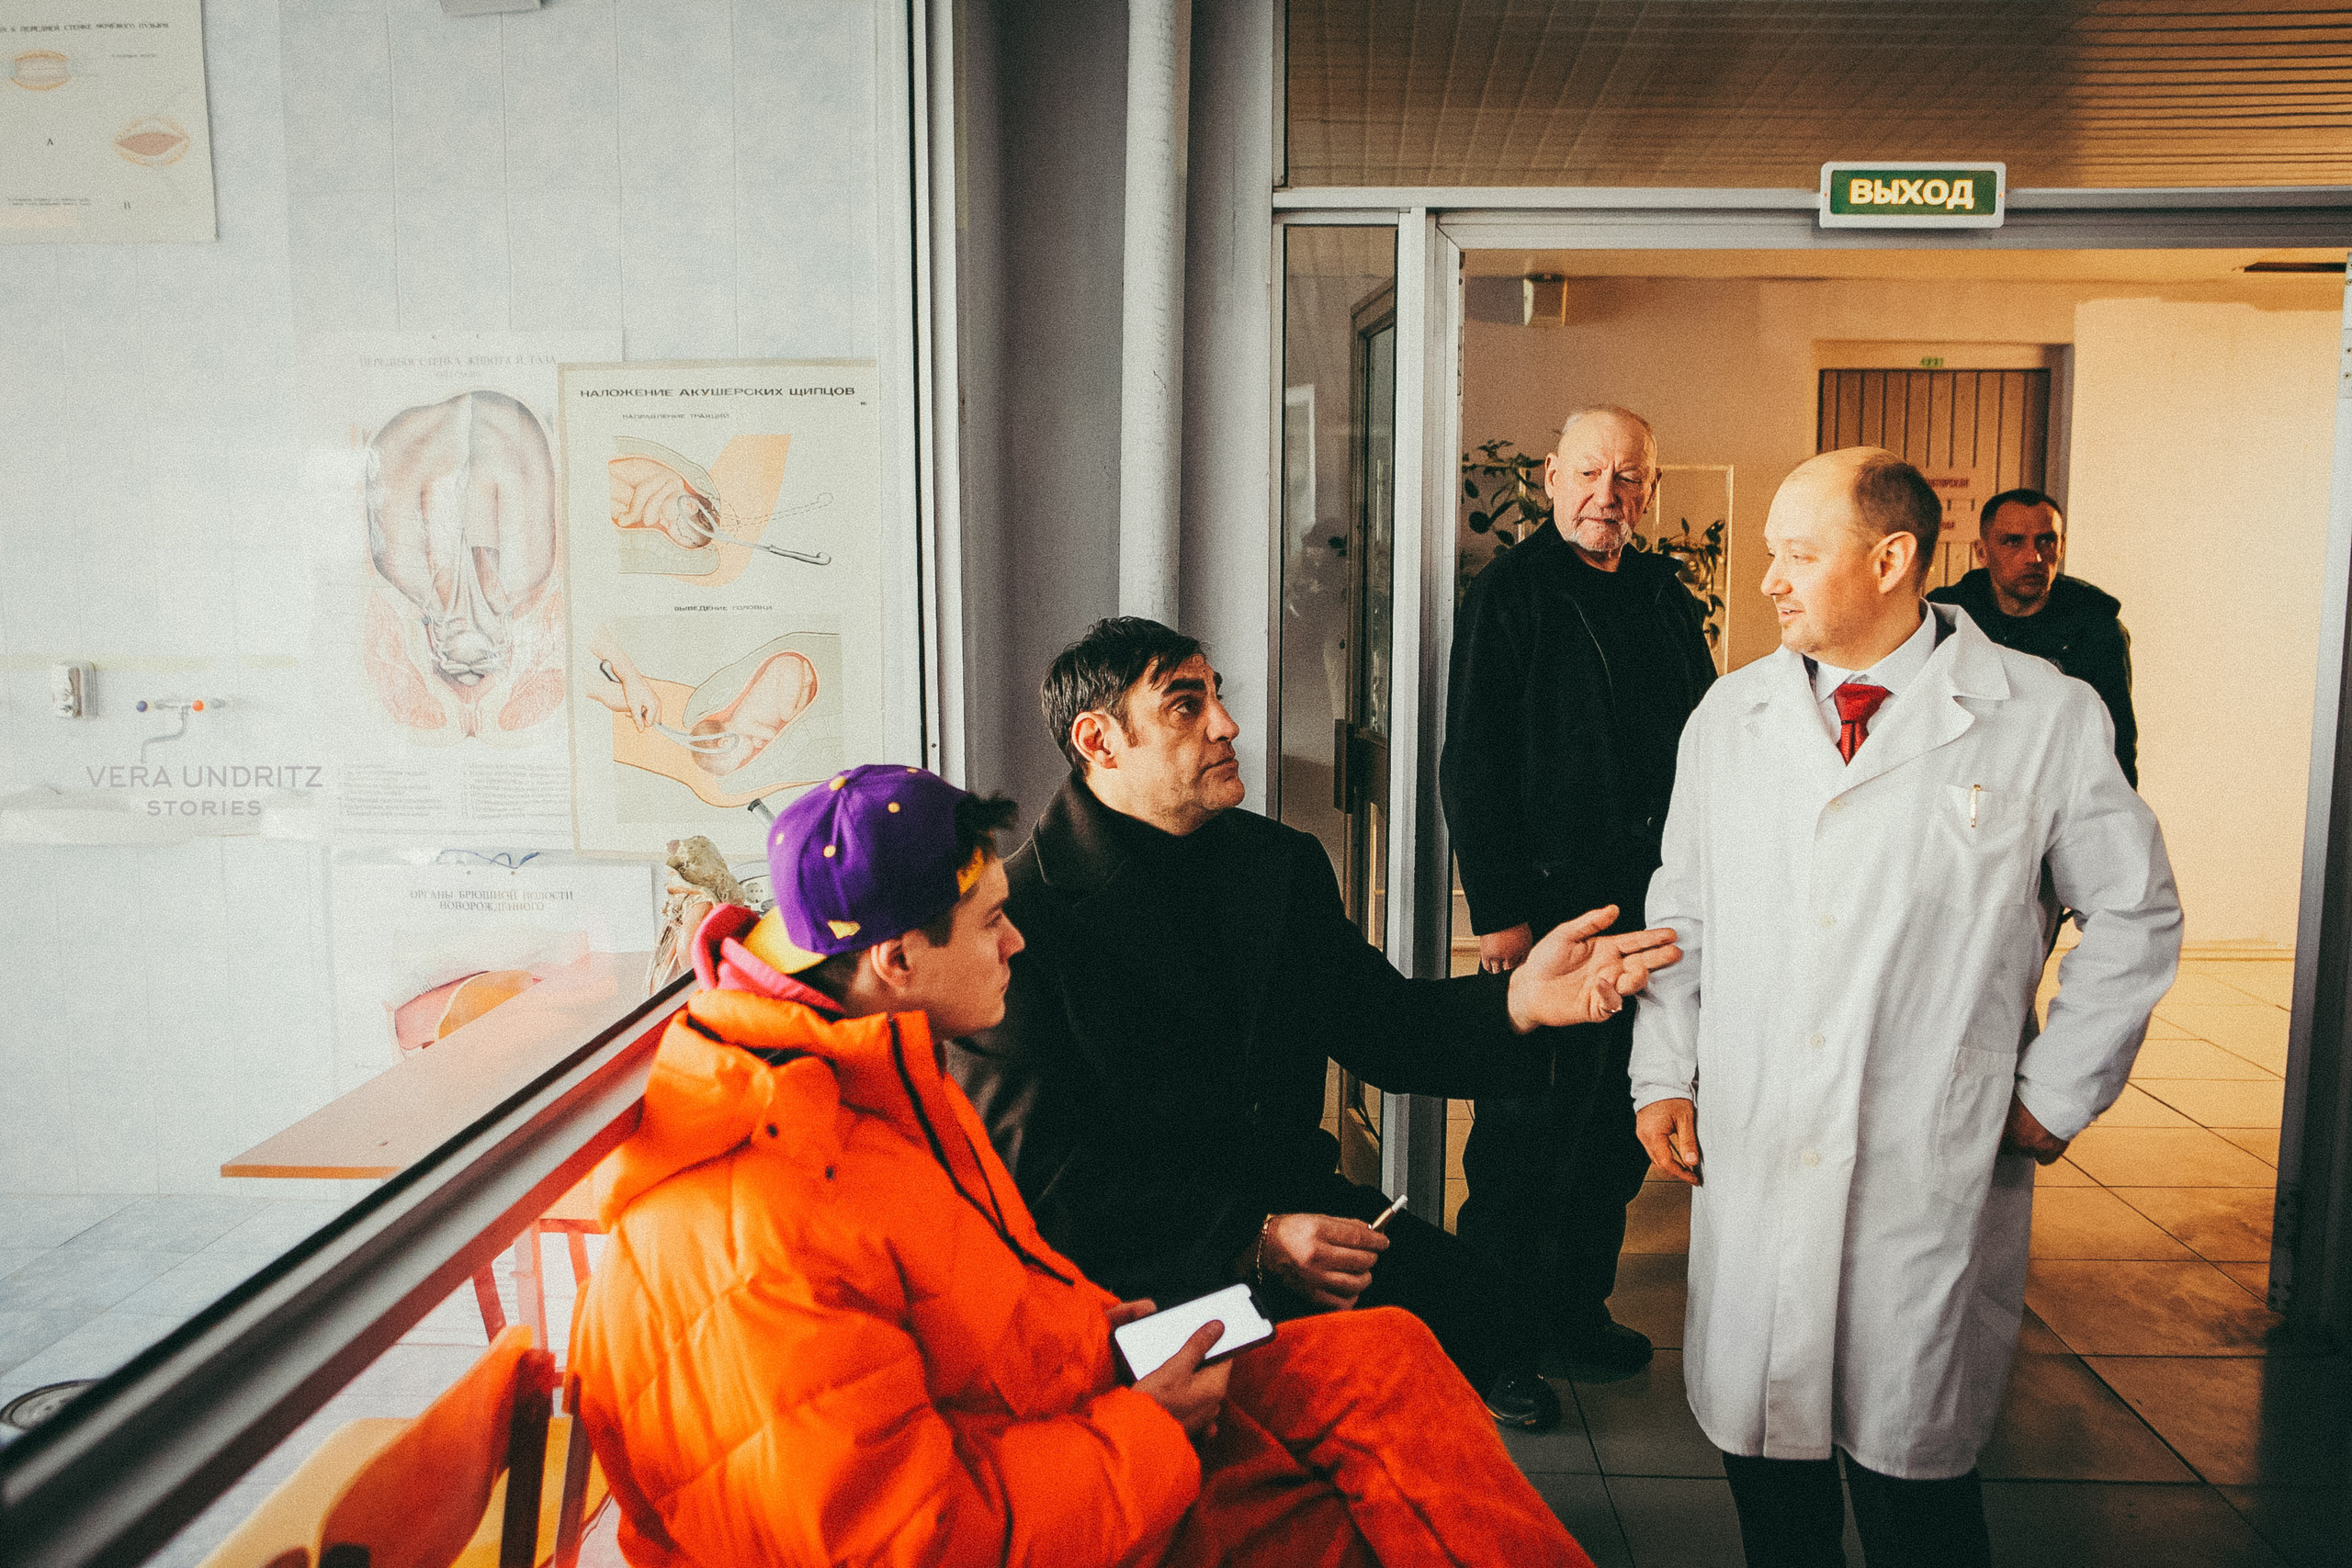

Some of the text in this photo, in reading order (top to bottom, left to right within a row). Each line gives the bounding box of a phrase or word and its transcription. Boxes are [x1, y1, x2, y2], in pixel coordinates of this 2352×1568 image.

[1849, 178, 1974, 210] ВЫХОД
[580, 387, 856, 398] НАЛОЖЕНИЕ АКУШЕРСКИХ ЩИПЦОВ
[410, 890, 453, 900] ОРГАНЫ
[458, 889, 518, 900] БРЮШНОЙ
